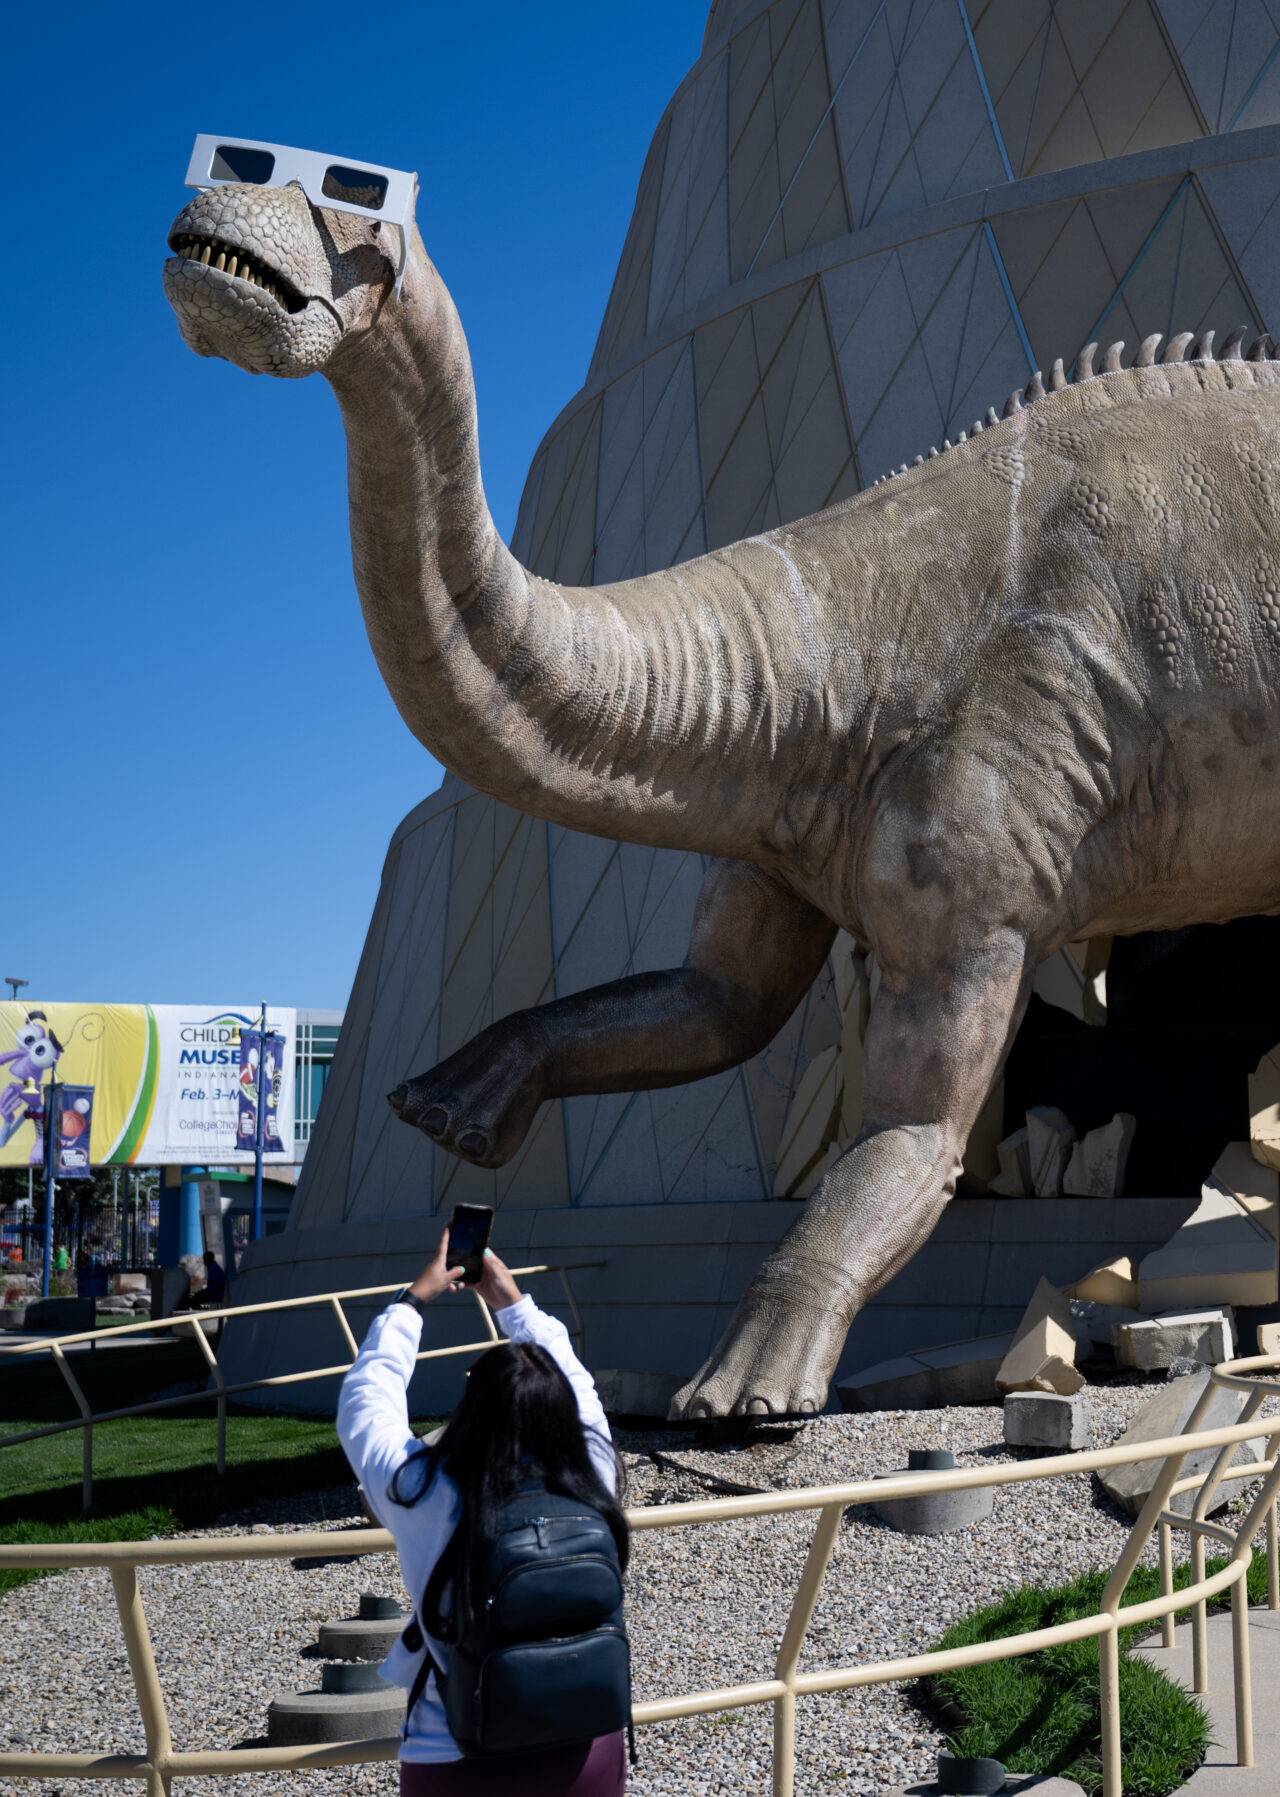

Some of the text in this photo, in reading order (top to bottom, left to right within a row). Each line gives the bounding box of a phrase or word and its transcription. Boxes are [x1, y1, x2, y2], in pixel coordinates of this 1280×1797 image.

[179, 1049, 240, 1065] MUSE
[178, 1071, 237, 1079] INDIANA
[181, 1088, 239, 1100] Feb. 3–M
[179, 1119, 238, 1132] CollegeChoi
